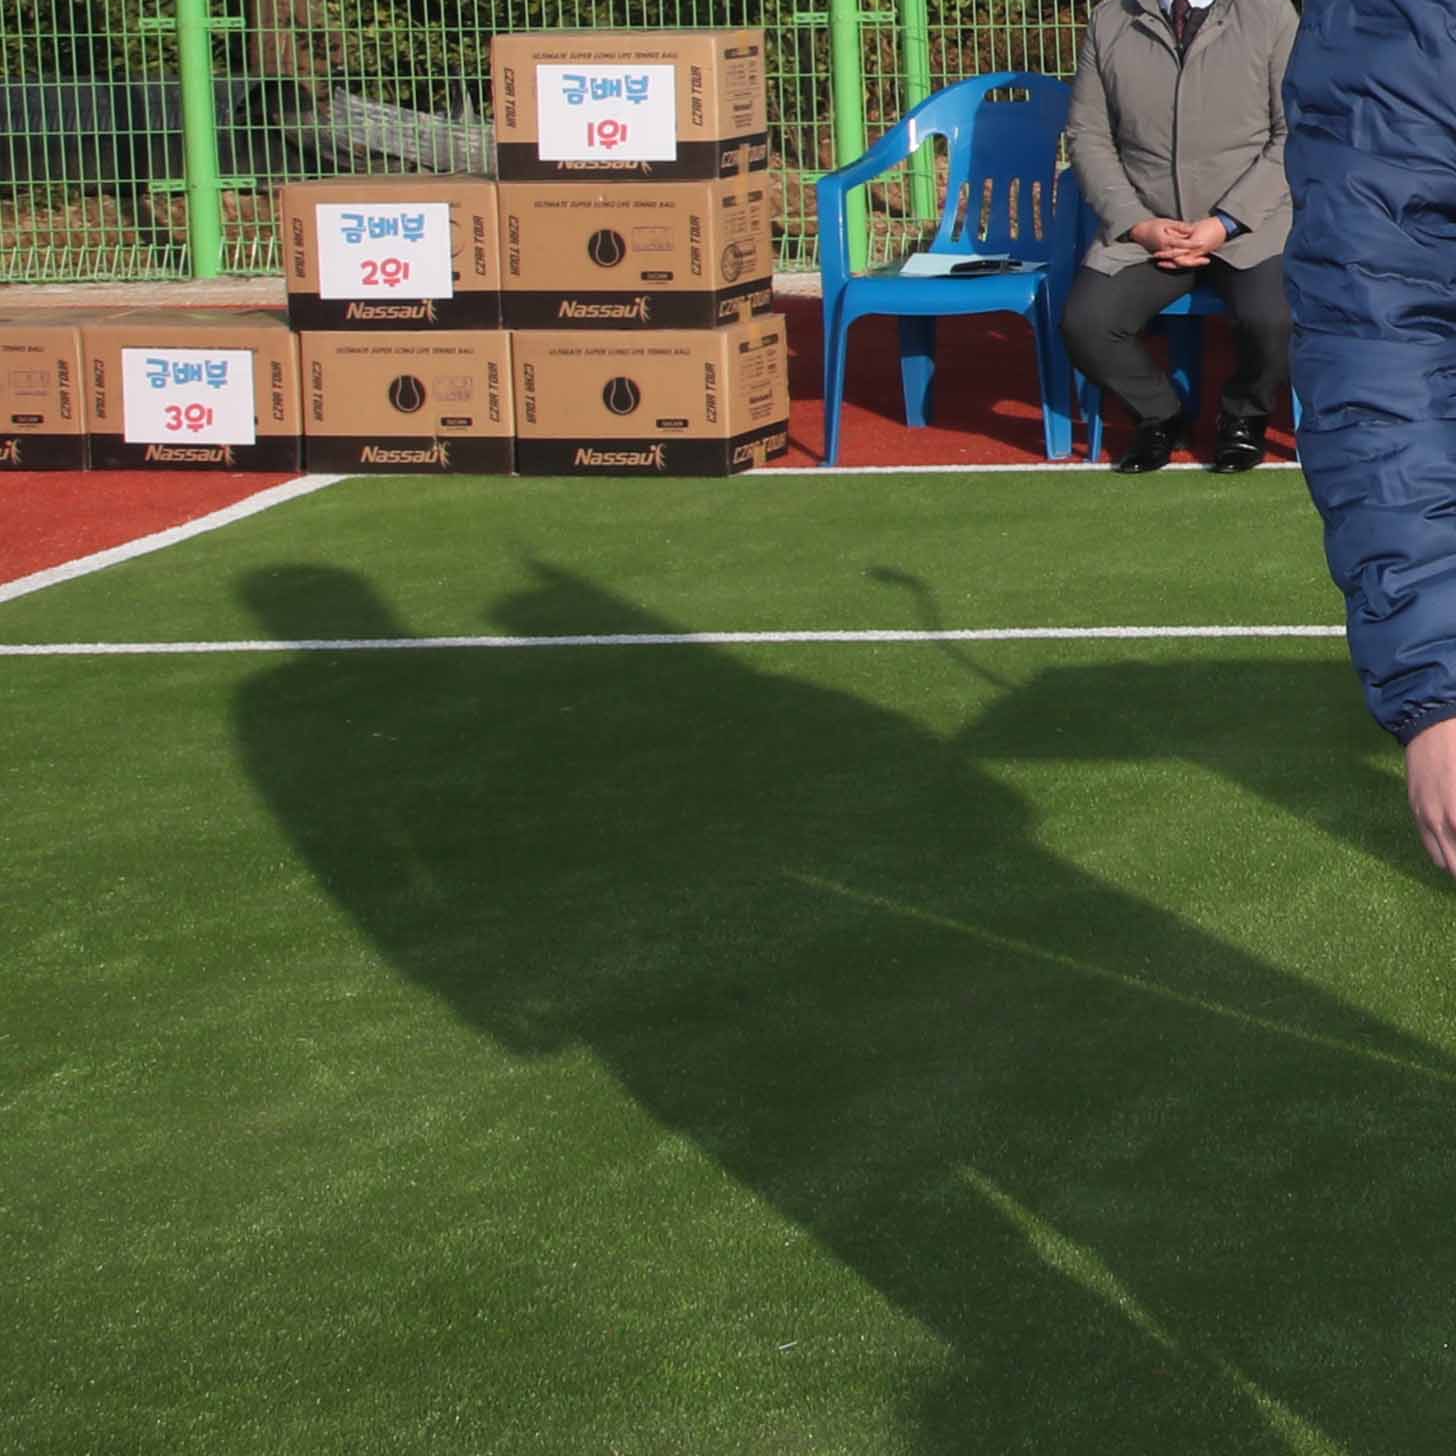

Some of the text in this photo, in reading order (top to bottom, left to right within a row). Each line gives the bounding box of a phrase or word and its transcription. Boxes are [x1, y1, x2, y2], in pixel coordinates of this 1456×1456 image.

[562, 73, 649, 105] 금배부
[340, 213, 425, 244] 금배부
[360, 257, 411, 287] 2위
[345, 301, 426, 320] Nassau
[558, 300, 638, 319] Nassau
[145, 358, 228, 389] 금배부
[704, 362, 718, 423] CZAR TOUR
[164, 402, 213, 432] 3위
[145, 444, 225, 462] Nassau
[360, 444, 439, 463] Nassau
[574, 447, 655, 467] Nassau
